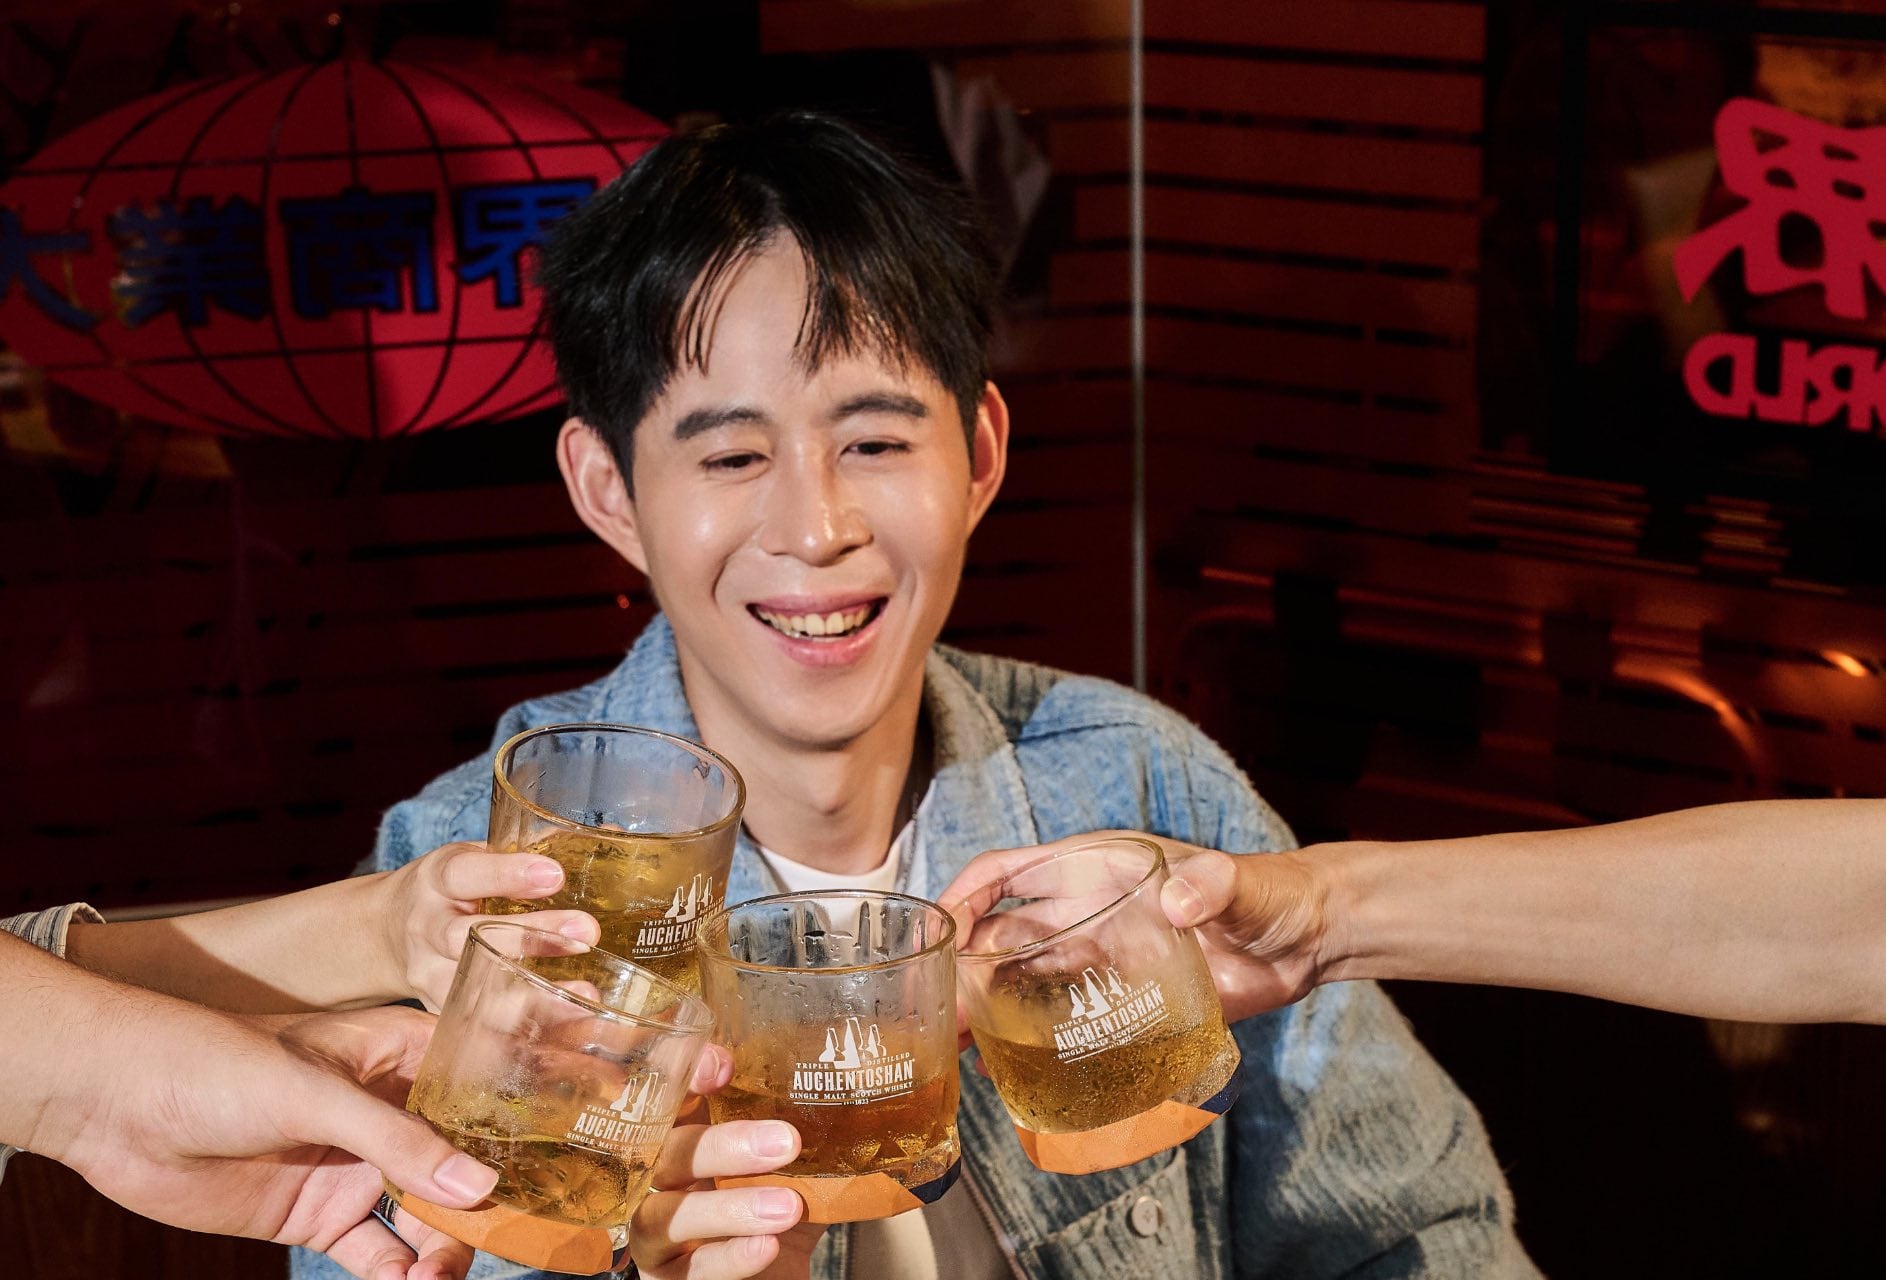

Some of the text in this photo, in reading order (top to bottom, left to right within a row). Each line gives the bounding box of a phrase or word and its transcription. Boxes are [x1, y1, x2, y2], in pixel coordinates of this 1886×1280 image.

[643, 919, 672, 927] TRIPLE
[1053, 1018, 1084, 1031] TRIPLE
[1054, 986, 1165, 1052] AUCHENTOSHAN
[867, 1052, 910, 1066] DISTILLED
[1058, 1047, 1085, 1060] SINGLE
[793, 1060, 913, 1092] AUCHENTOSHAN
[789, 1092, 819, 1100] SINGLE
[850, 1089, 881, 1098] SCOTCH
[884, 1081, 913, 1093] WHISKY
[586, 1104, 616, 1118] TRIPLE
[566, 1132, 595, 1145] SINGLE
